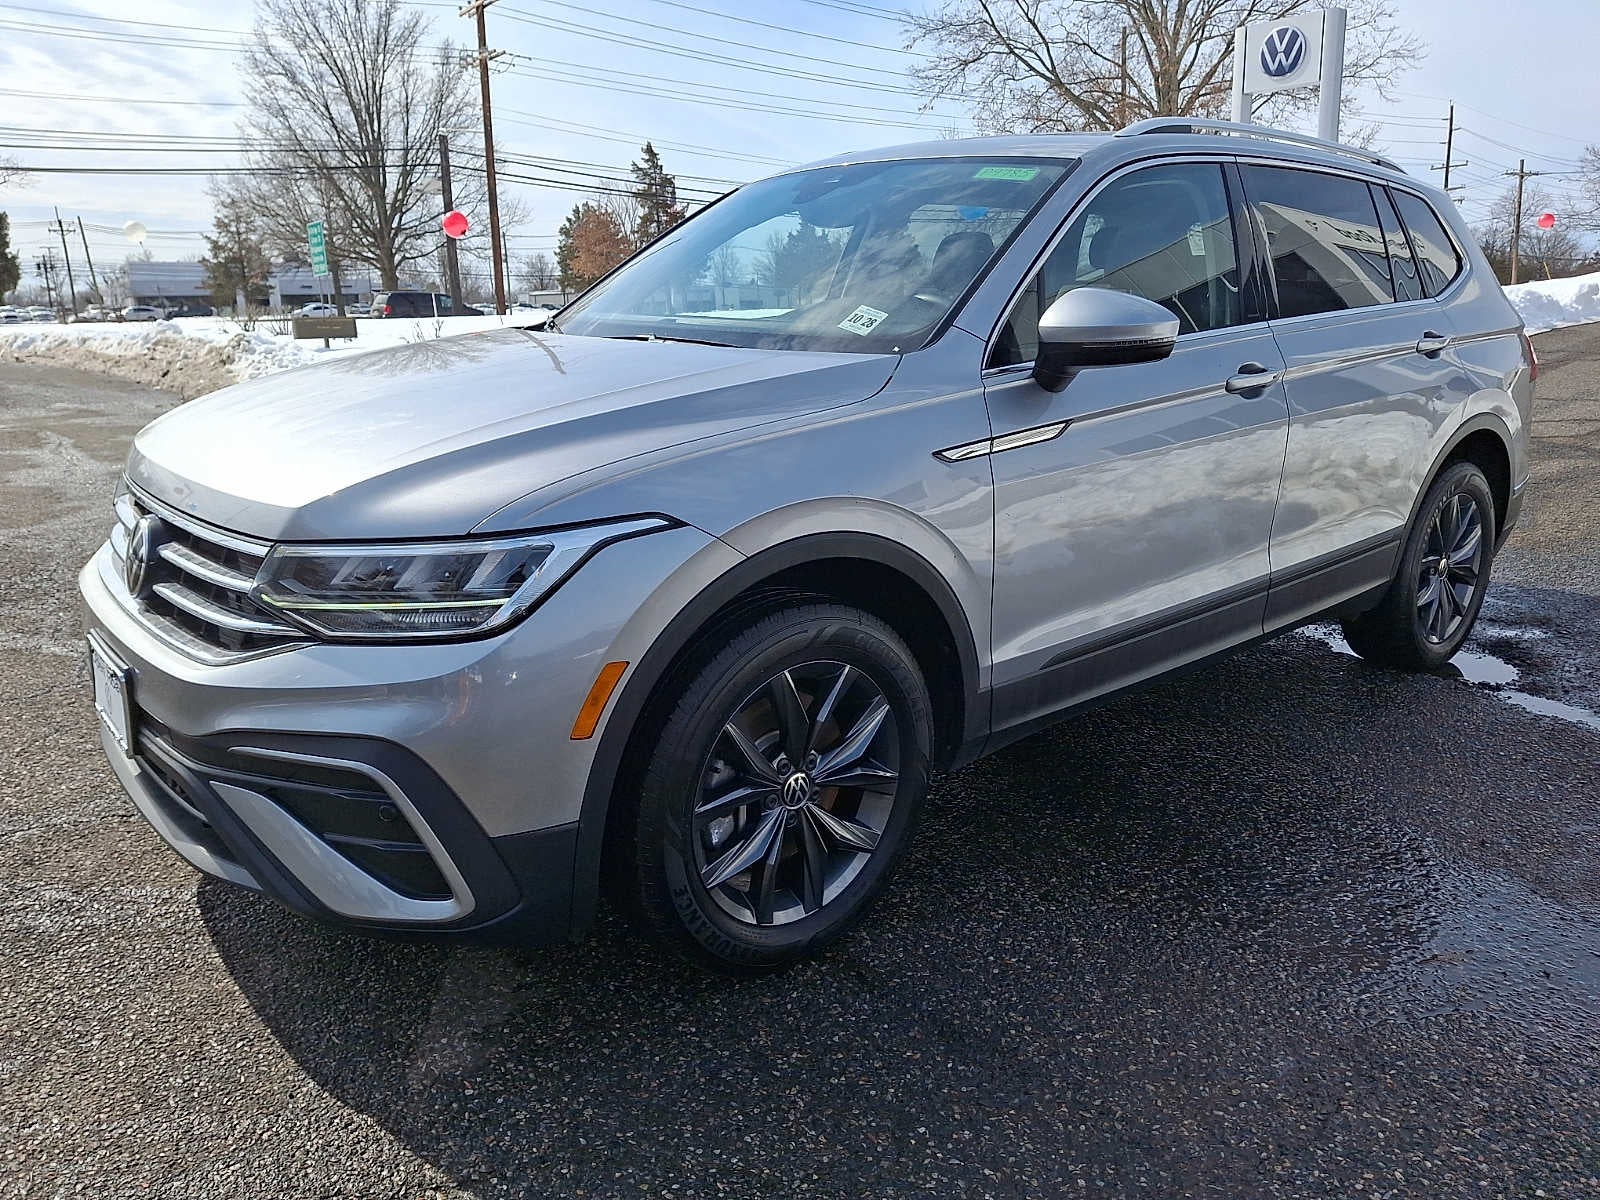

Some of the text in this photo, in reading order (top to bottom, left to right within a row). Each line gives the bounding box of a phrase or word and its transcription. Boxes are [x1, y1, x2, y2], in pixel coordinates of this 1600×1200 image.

[1261, 26, 1304, 76] VW
[847, 314, 877, 328] 10 28
[784, 773, 810, 808] VW
